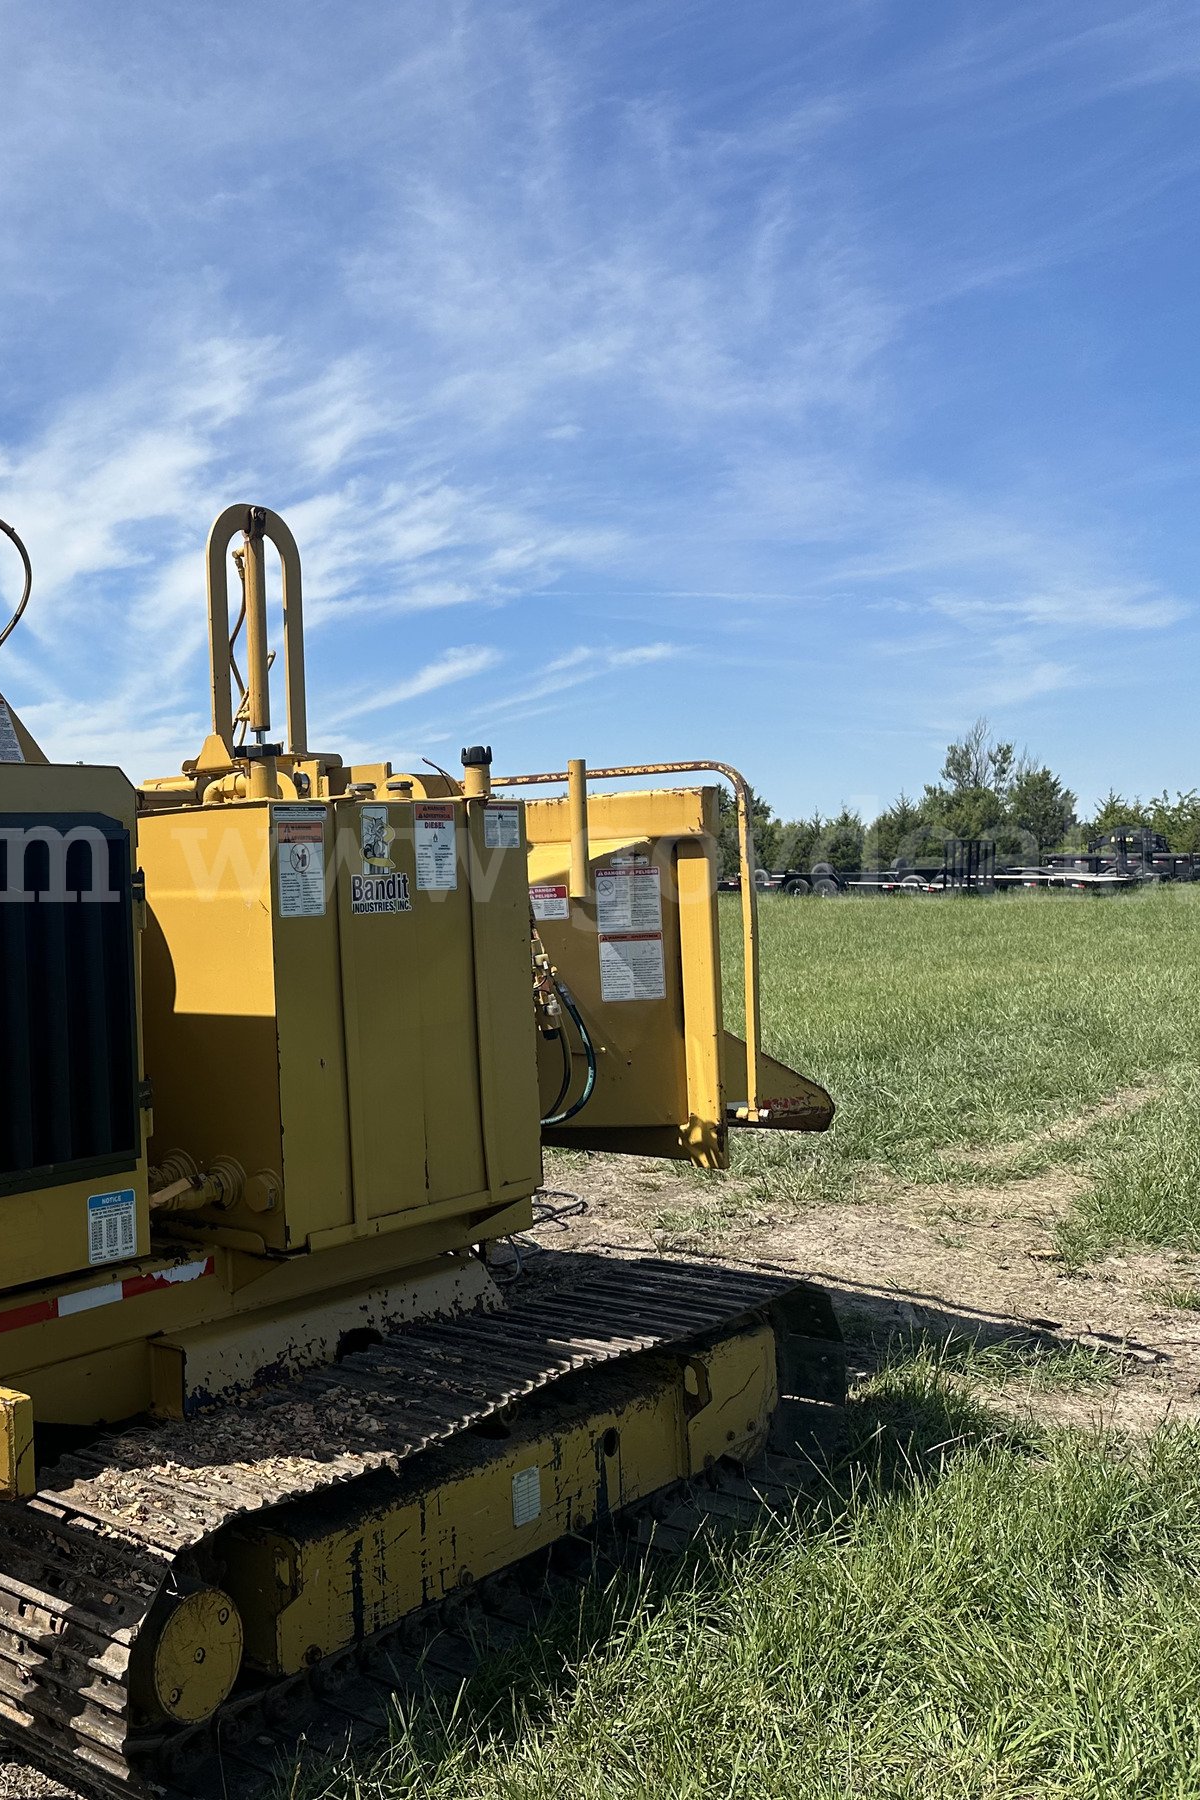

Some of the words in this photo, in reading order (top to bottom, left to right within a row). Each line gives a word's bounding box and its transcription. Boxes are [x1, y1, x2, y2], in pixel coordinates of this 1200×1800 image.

[424, 821, 446, 830] DIESEL
[351, 873, 410, 902] Bandit
[352, 901, 397, 914] INDUSTRIES,
[397, 899, 412, 911] INC.
[101, 1195, 122, 1205] NOTICE
